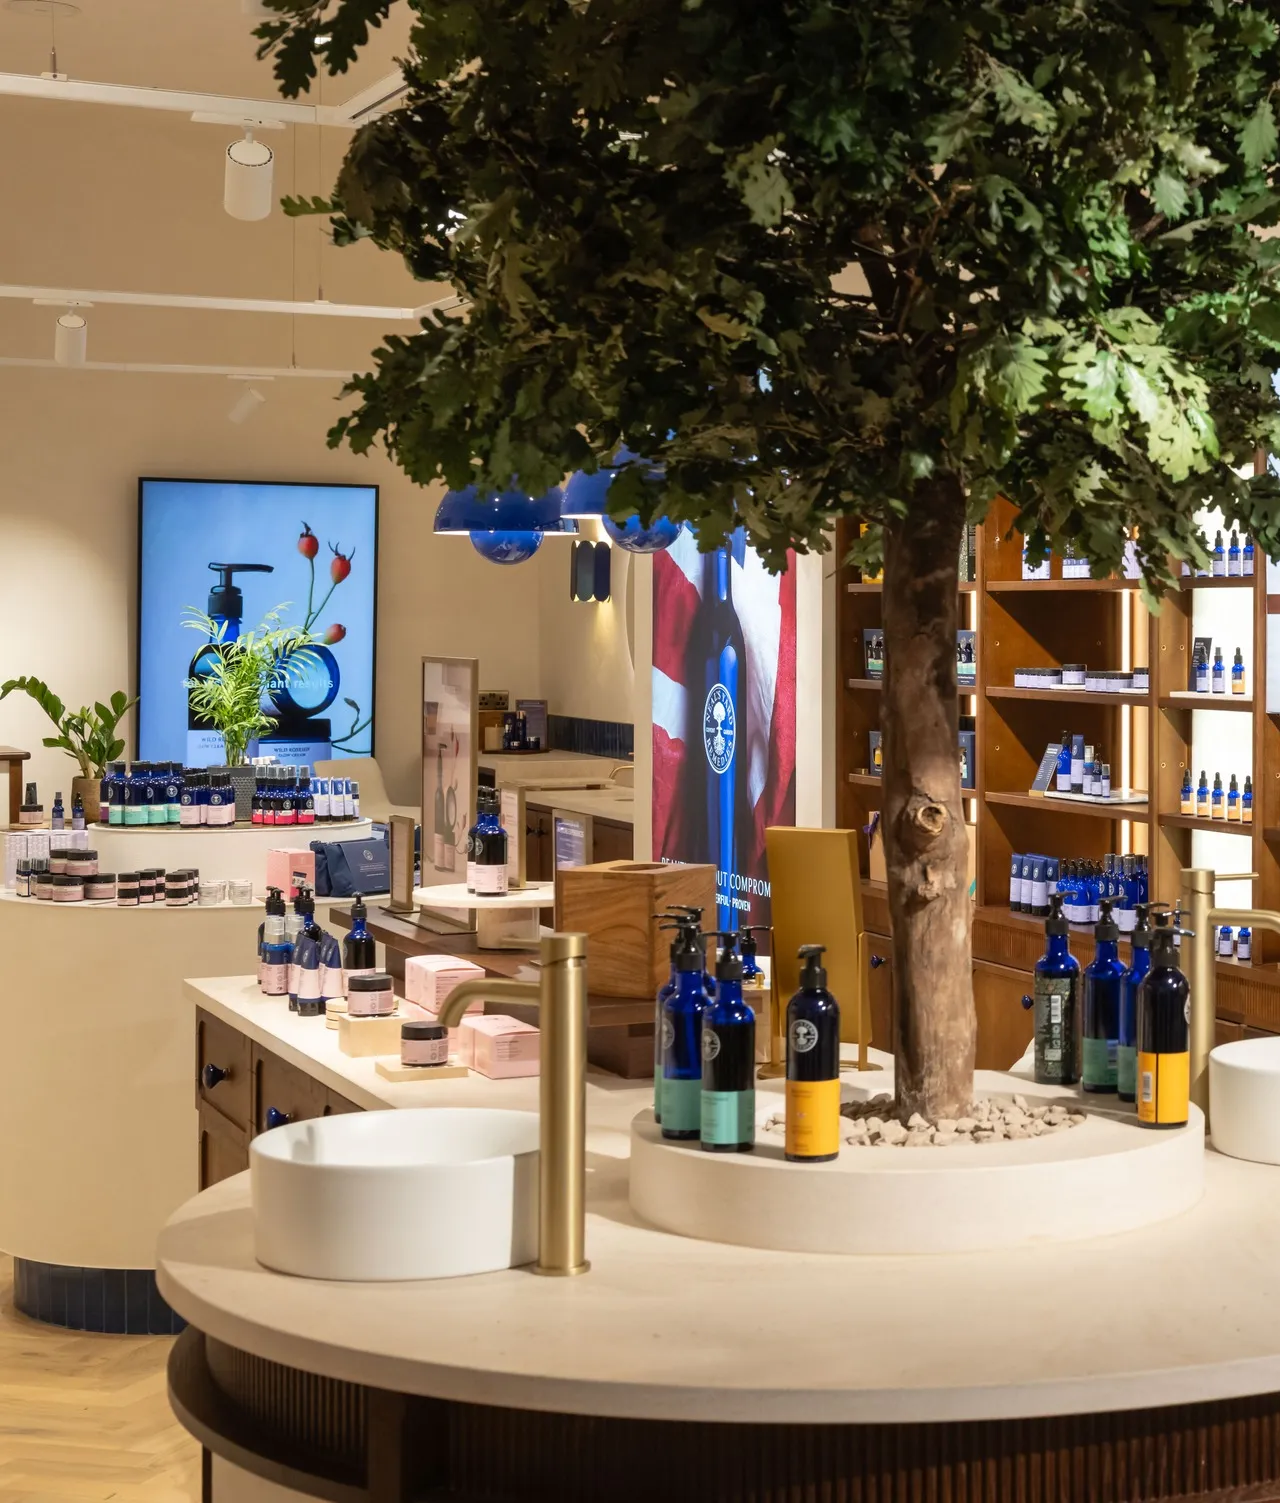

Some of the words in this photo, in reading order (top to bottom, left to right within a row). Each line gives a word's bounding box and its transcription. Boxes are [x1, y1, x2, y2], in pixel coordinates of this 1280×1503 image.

[293, 680, 334, 689] results
[706, 737, 733, 767] REMEDIES
[731, 897, 751, 912] PROVEN
